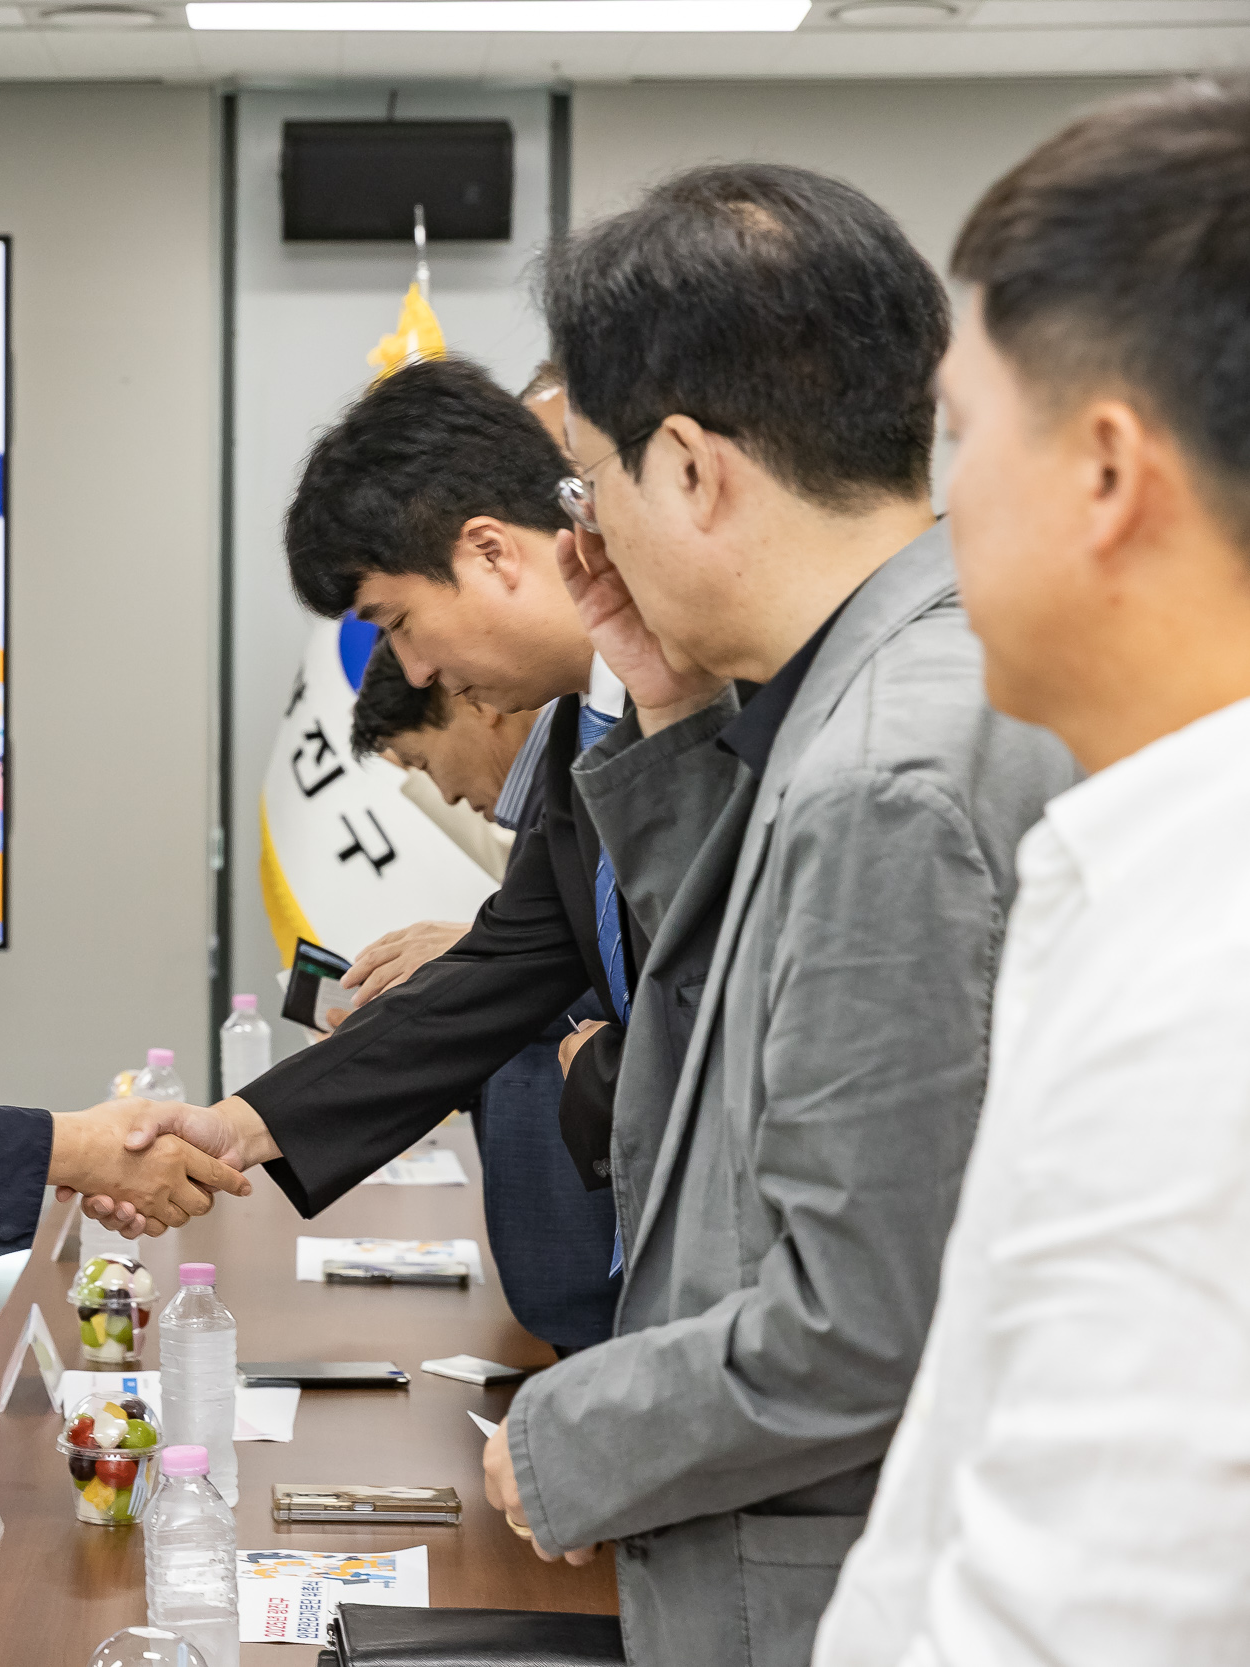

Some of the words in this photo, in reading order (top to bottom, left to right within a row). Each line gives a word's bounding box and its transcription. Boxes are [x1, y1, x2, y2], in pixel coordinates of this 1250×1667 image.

[267, 1597, 290, 1614] 광진구
[265, 1615, 287, 1637] 2025년
[297, 1599, 321, 1638] 안전관리자문단
